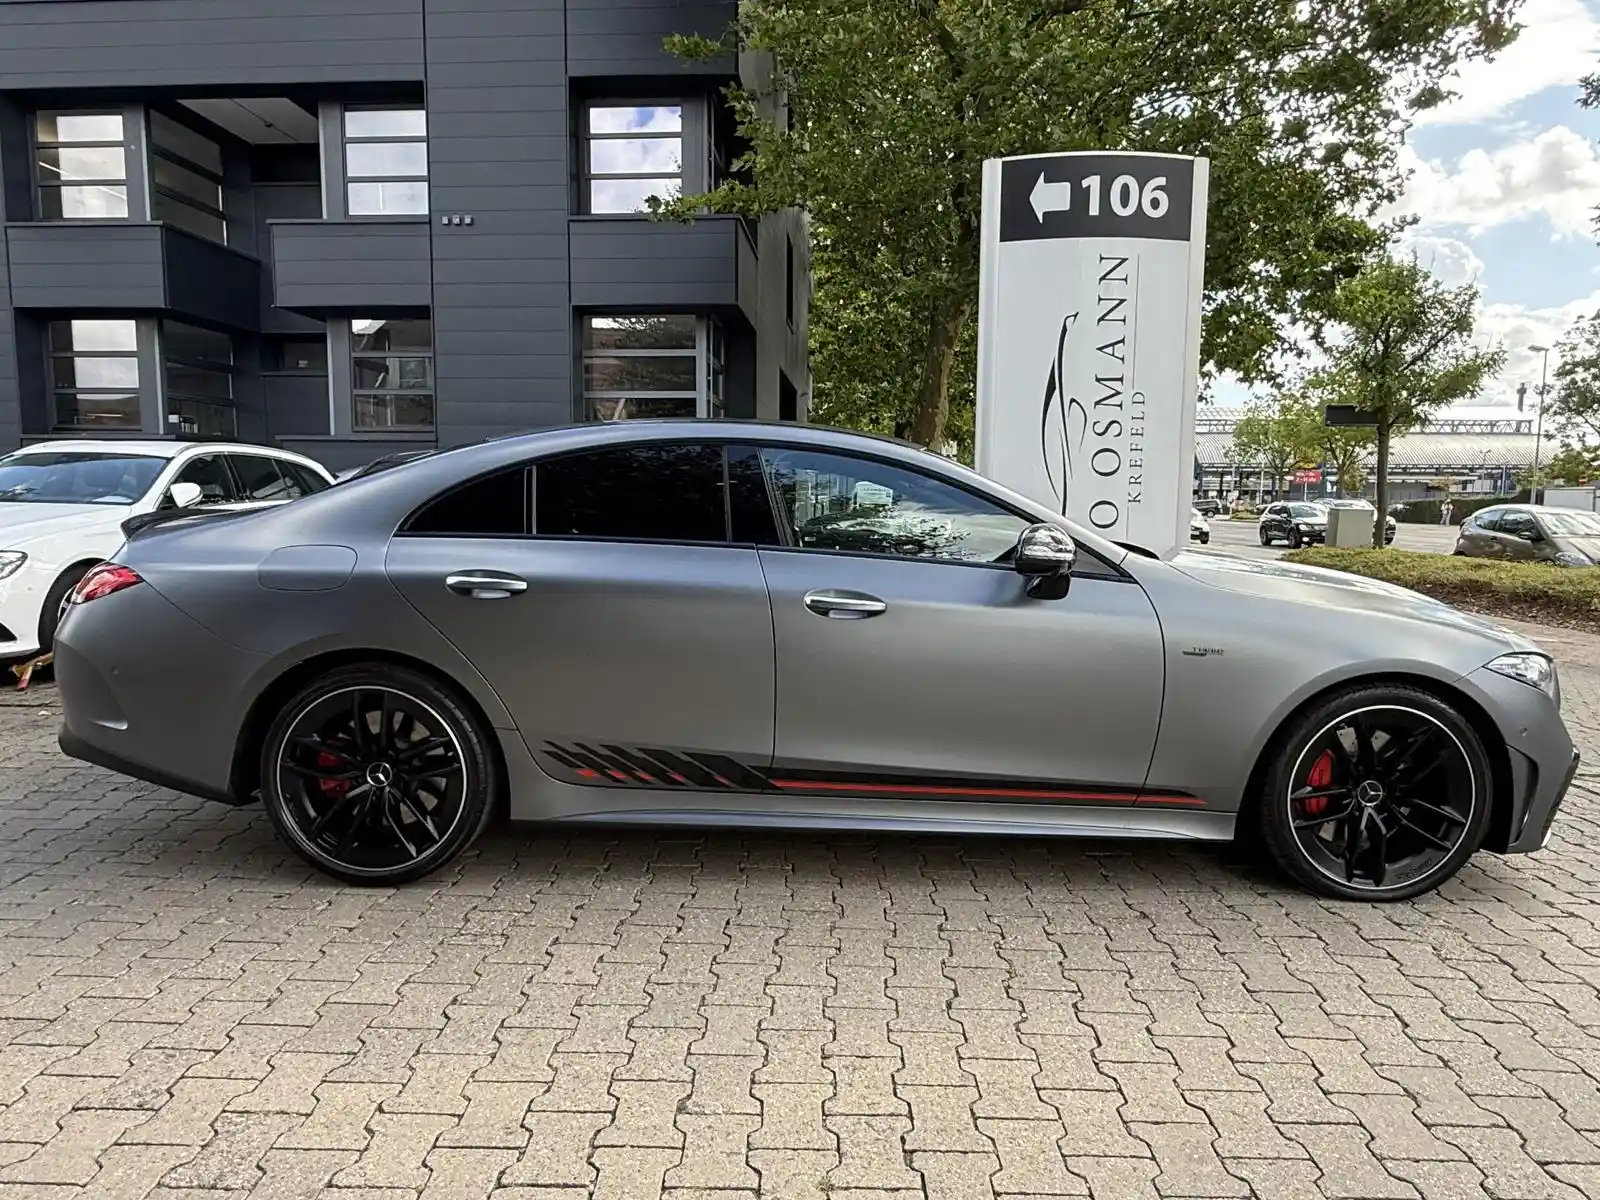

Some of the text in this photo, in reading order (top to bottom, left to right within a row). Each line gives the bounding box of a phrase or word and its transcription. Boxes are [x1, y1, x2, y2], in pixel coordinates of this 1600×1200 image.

[1081, 174, 1169, 219] 106
[1091, 253, 1129, 477] OSMANN
[1127, 390, 1146, 504] KREFELD
